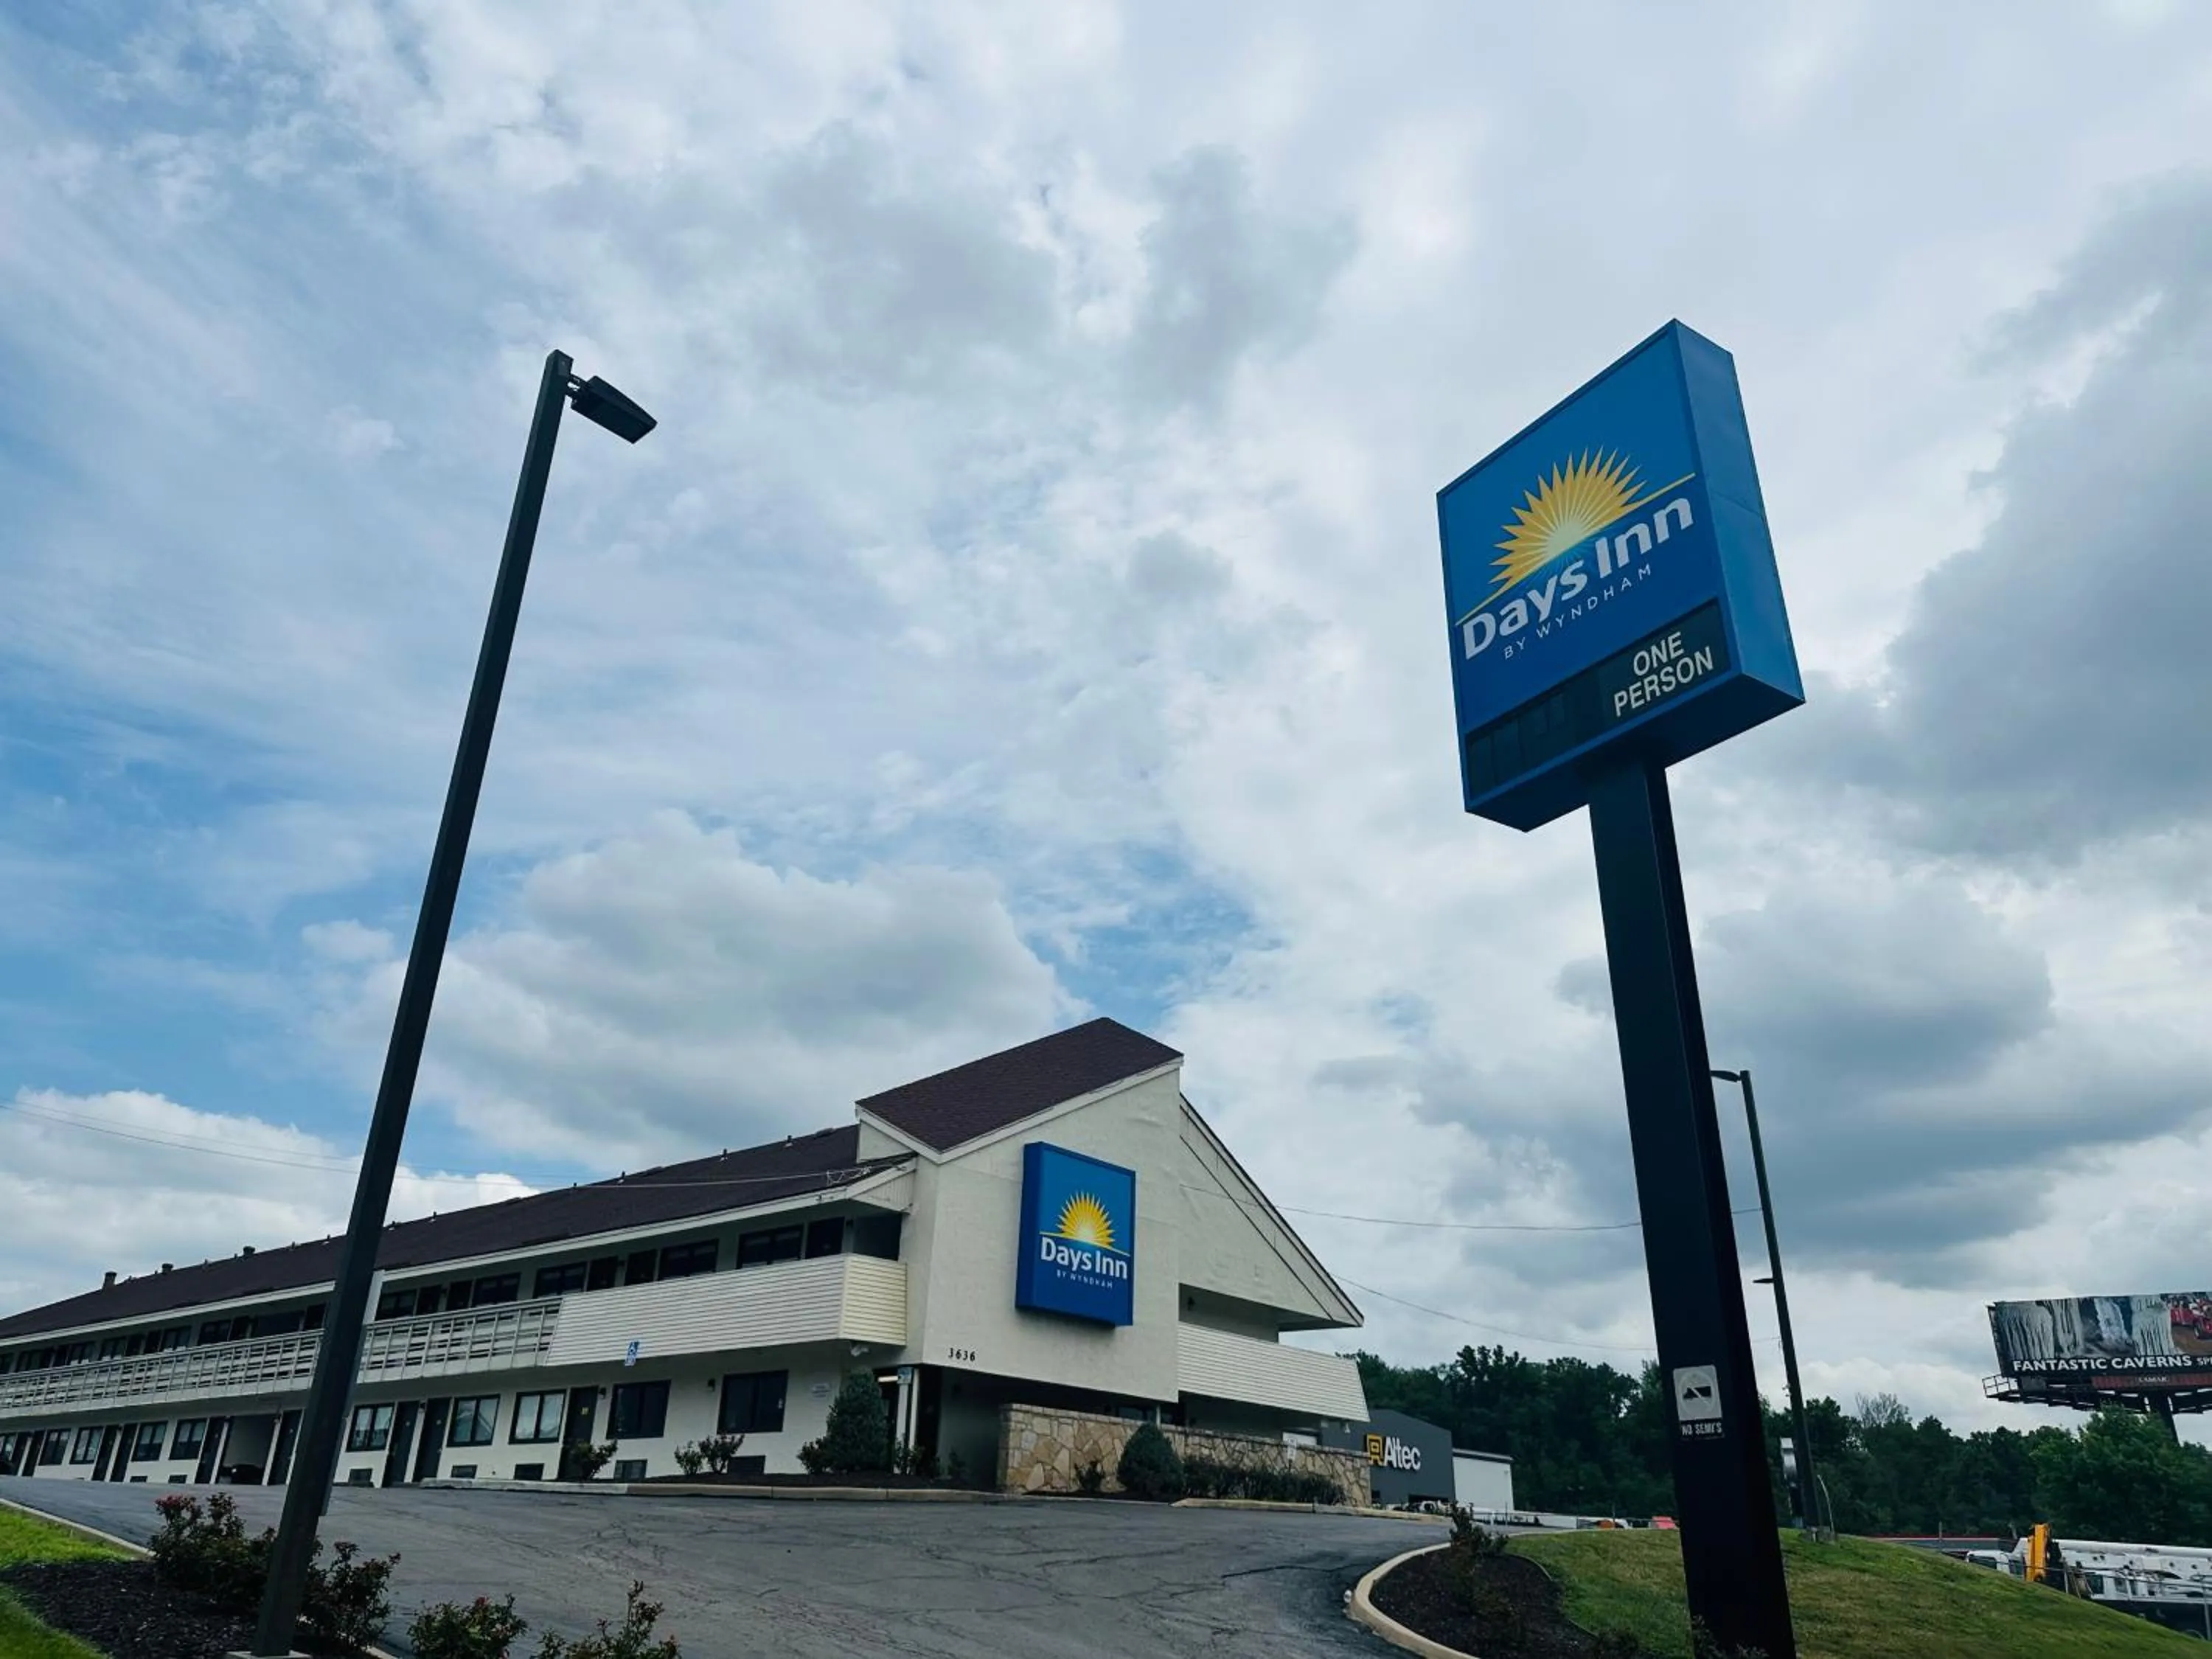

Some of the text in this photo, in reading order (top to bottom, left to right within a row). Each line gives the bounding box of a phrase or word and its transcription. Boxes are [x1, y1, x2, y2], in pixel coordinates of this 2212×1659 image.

[1462, 498, 1694, 661] Days Inn
[1503, 564, 1652, 661] BY WYNDHAM
[1613, 631, 1714, 717] ONE PERSON
[1040, 1236, 1128, 1280] Days Inn
[1056, 1269, 1113, 1290] BY WYNDHAM
[948, 1347, 976, 1363] 3636
[2013, 1354, 2212, 1372] FANTASTIC CAVERNS SP
[1681, 1424, 1693, 1436] NO
[1383, 1436, 1422, 1471] Altec
